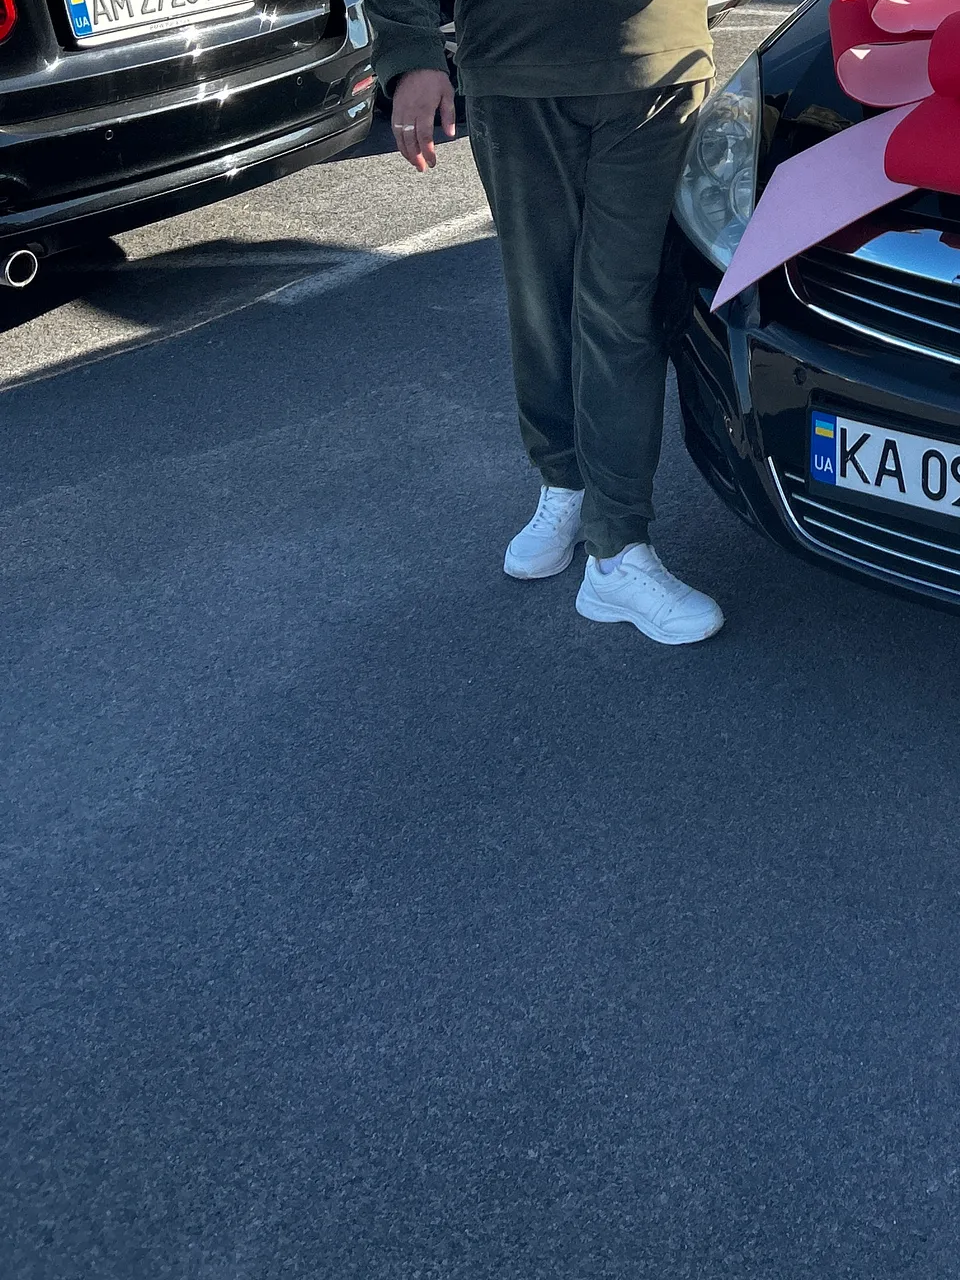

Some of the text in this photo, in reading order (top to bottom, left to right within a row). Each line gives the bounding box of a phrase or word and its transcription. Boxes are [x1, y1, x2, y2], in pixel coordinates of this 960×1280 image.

[76, 17, 90, 29] UA
[814, 455, 834, 474] UA
[839, 426, 907, 494] KA
